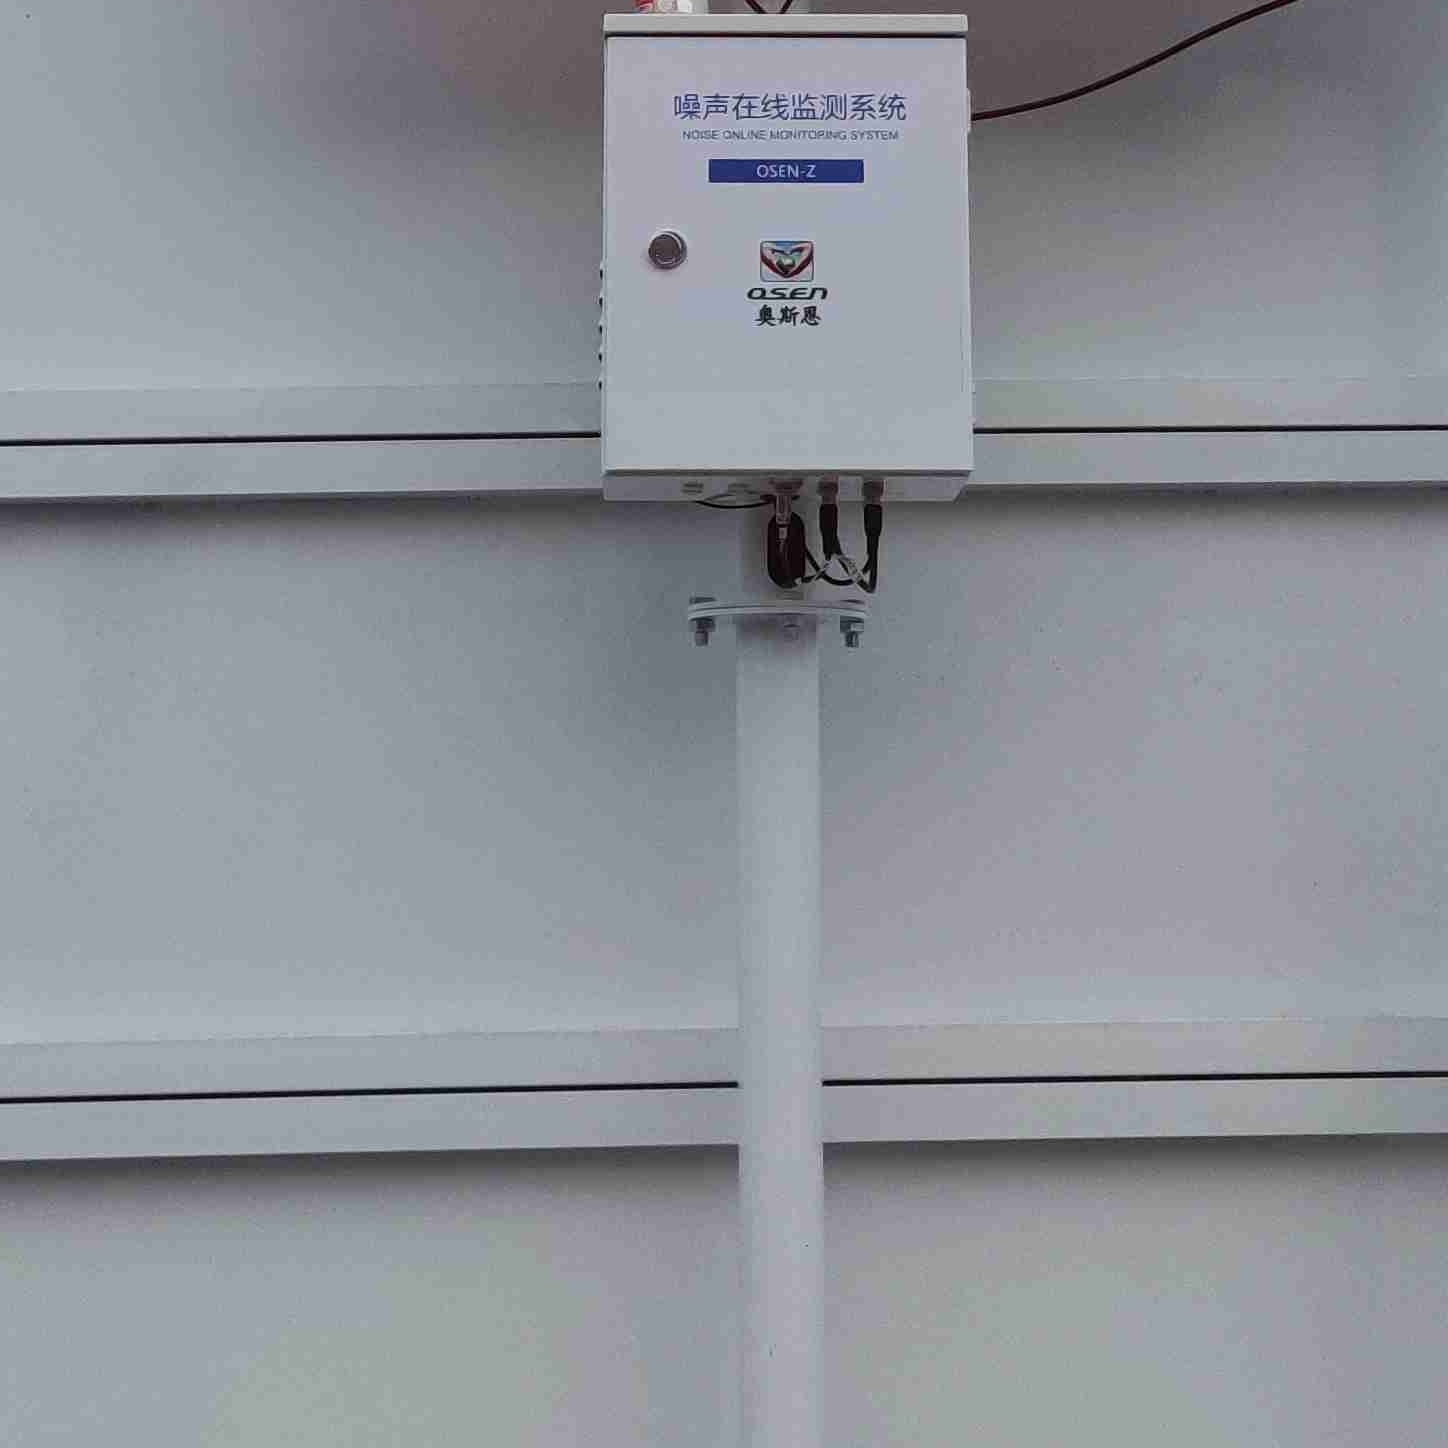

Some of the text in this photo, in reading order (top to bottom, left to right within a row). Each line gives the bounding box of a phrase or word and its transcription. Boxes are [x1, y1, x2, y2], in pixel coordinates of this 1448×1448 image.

[673, 92, 907, 121] 噪声在线监测系统
[682, 129, 719, 140] NOISE
[722, 129, 767, 140] ONLINE
[850, 129, 899, 141] SYSTEM
[756, 164, 817, 178] OSEN-Z
[755, 304, 821, 326] 奥斯恩
